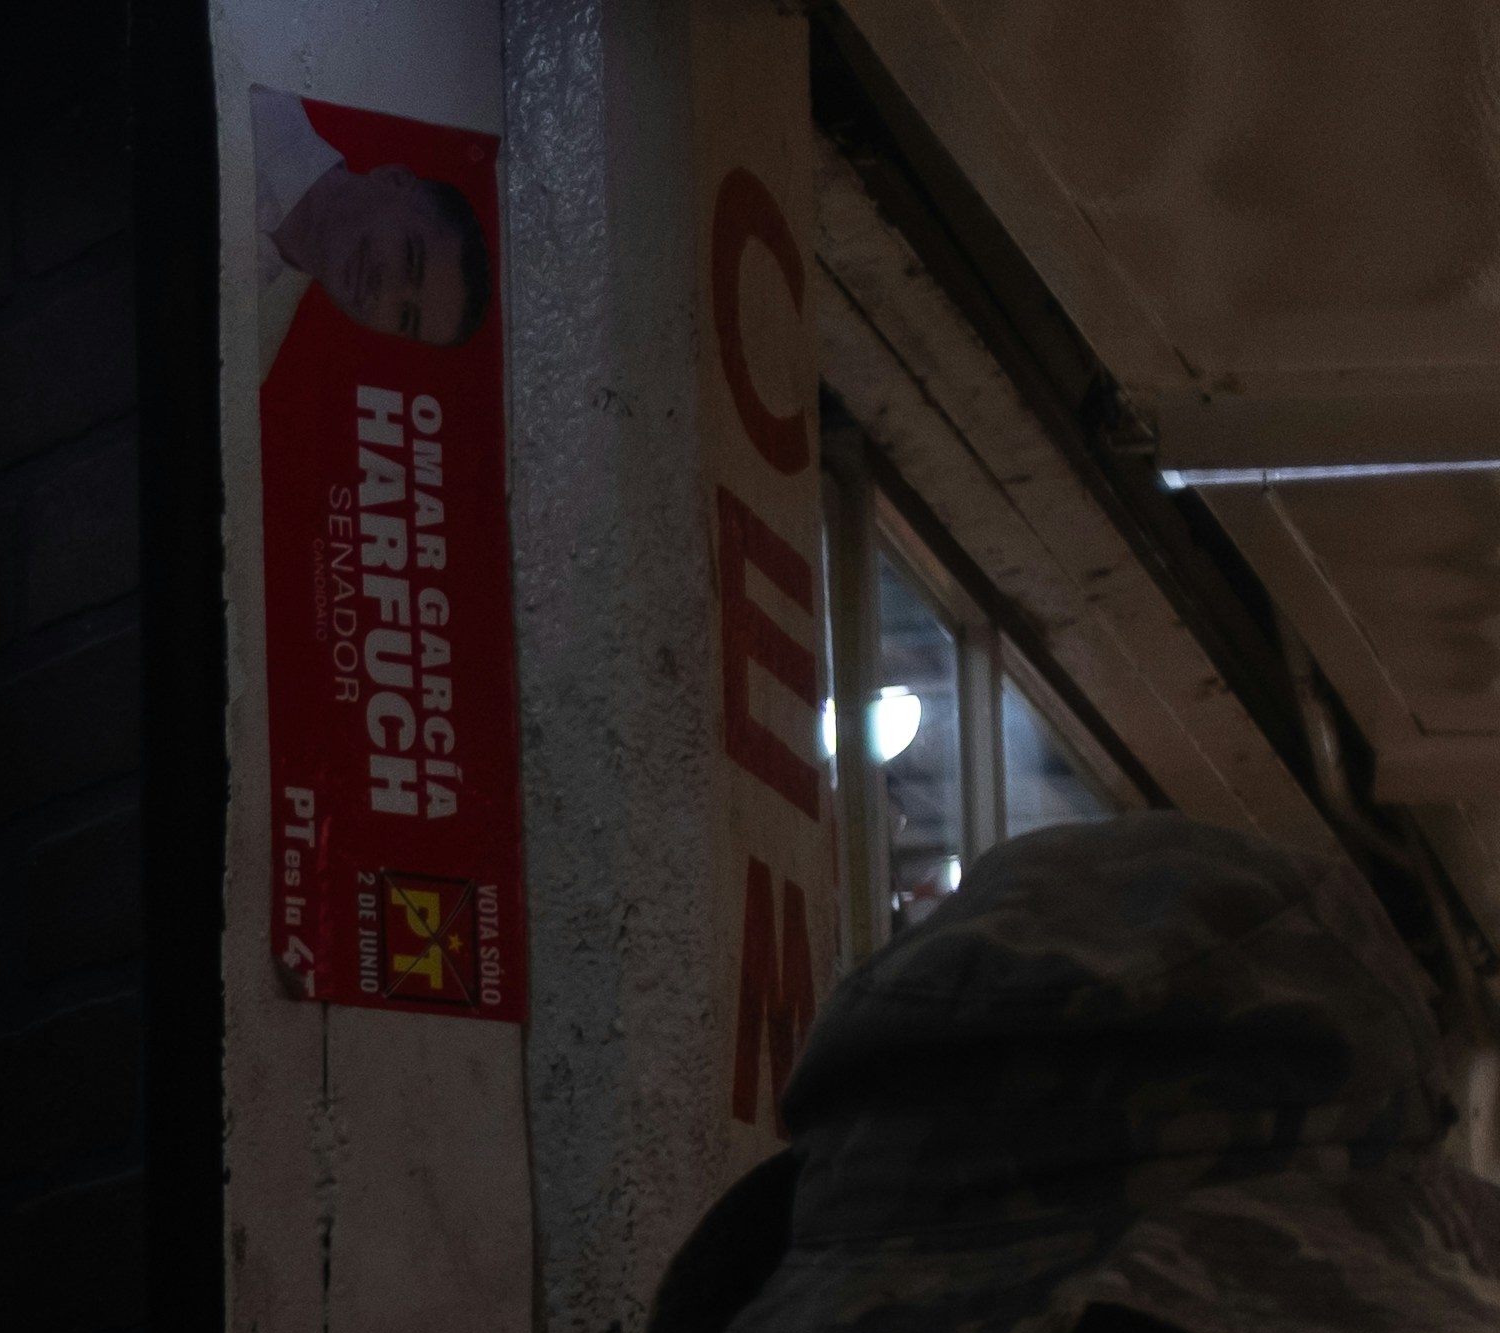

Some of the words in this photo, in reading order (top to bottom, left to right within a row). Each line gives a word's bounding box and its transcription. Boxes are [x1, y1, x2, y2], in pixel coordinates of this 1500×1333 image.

[409, 393, 447, 570] OMAR
[311, 537, 329, 643] CANDIDATO
[326, 483, 360, 703] SENADOR
[356, 383, 419, 818] HARFUCH
[418, 586, 463, 821] GARCÍA
[284, 785, 315, 848] PT
[284, 849, 302, 886] es
[356, 869, 376, 886] 2
[284, 896, 307, 925] la
[357, 891, 377, 922] DE
[390, 886, 444, 991] PT
[476, 883, 499, 941] VOTA
[358, 926, 380, 994] JUNIO
[480, 945, 503, 1005] SÓLO
